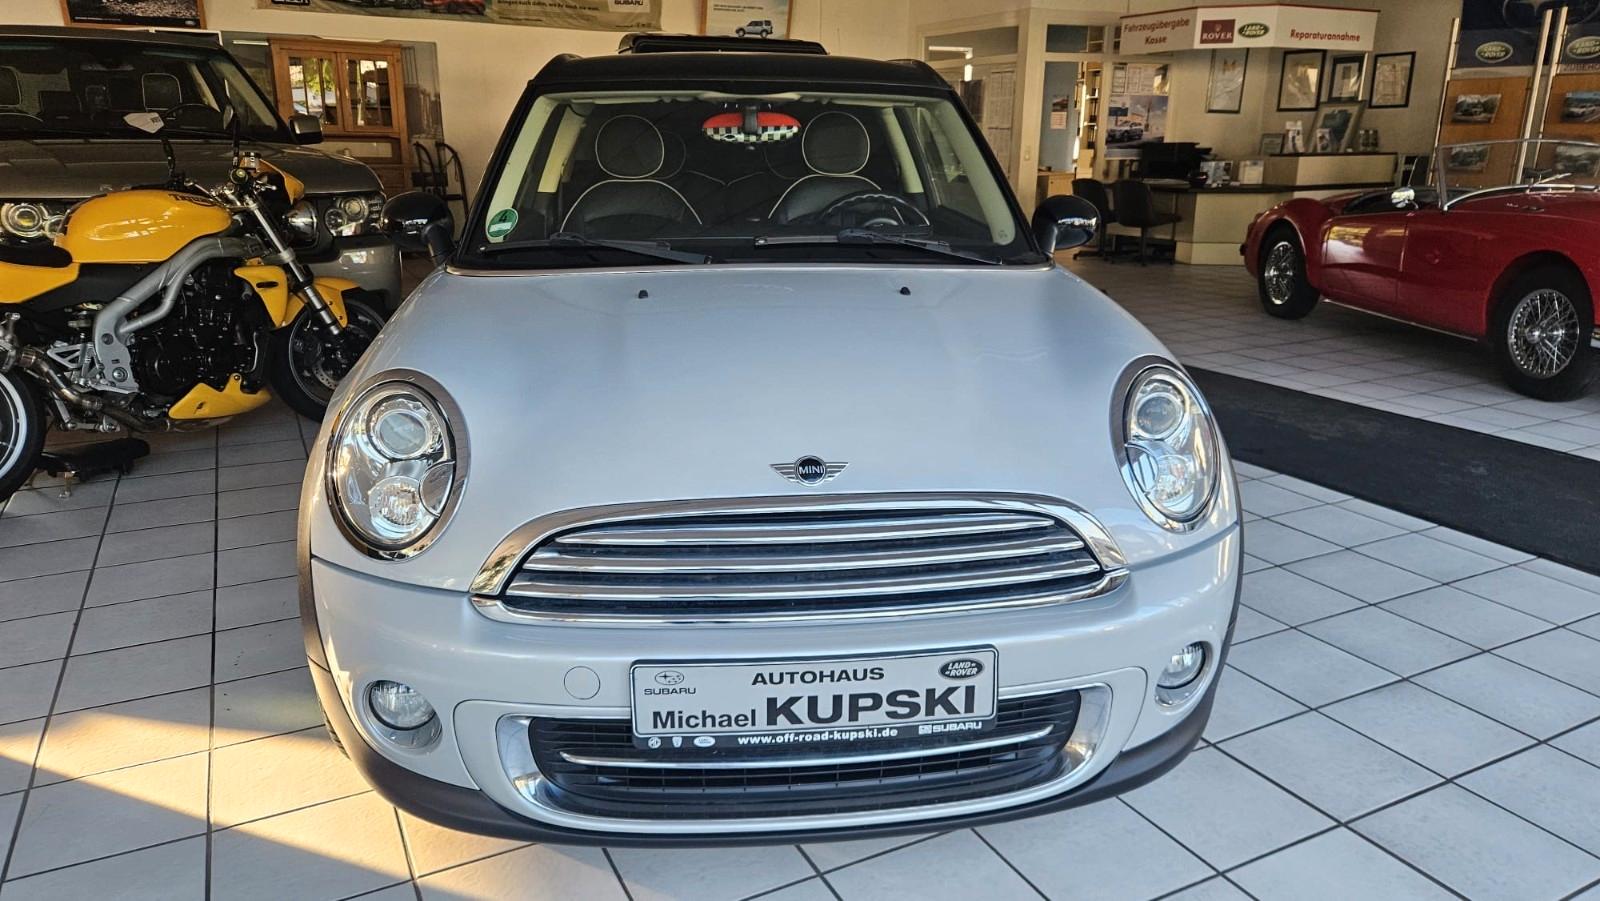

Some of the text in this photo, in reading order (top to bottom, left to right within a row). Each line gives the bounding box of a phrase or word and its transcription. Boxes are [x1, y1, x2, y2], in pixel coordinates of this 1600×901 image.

[1123, 17, 1190, 33] Fahrzeugübergabe
[1202, 32, 1233, 40] ROVER
[1290, 29, 1361, 41] Reparaturannahme
[1144, 36, 1168, 45] Kasse
[799, 465, 823, 474] MINI
[948, 661, 970, 670] LAND
[751, 667, 885, 685] AUTOHAUS
[950, 668, 978, 677] ROVER
[643, 687, 697, 695] SUBARU
[652, 685, 976, 729] Michael KUPSKI
[932, 721, 982, 733] SUBARU
[738, 728, 898, 745] www.off-road-kupski.de
